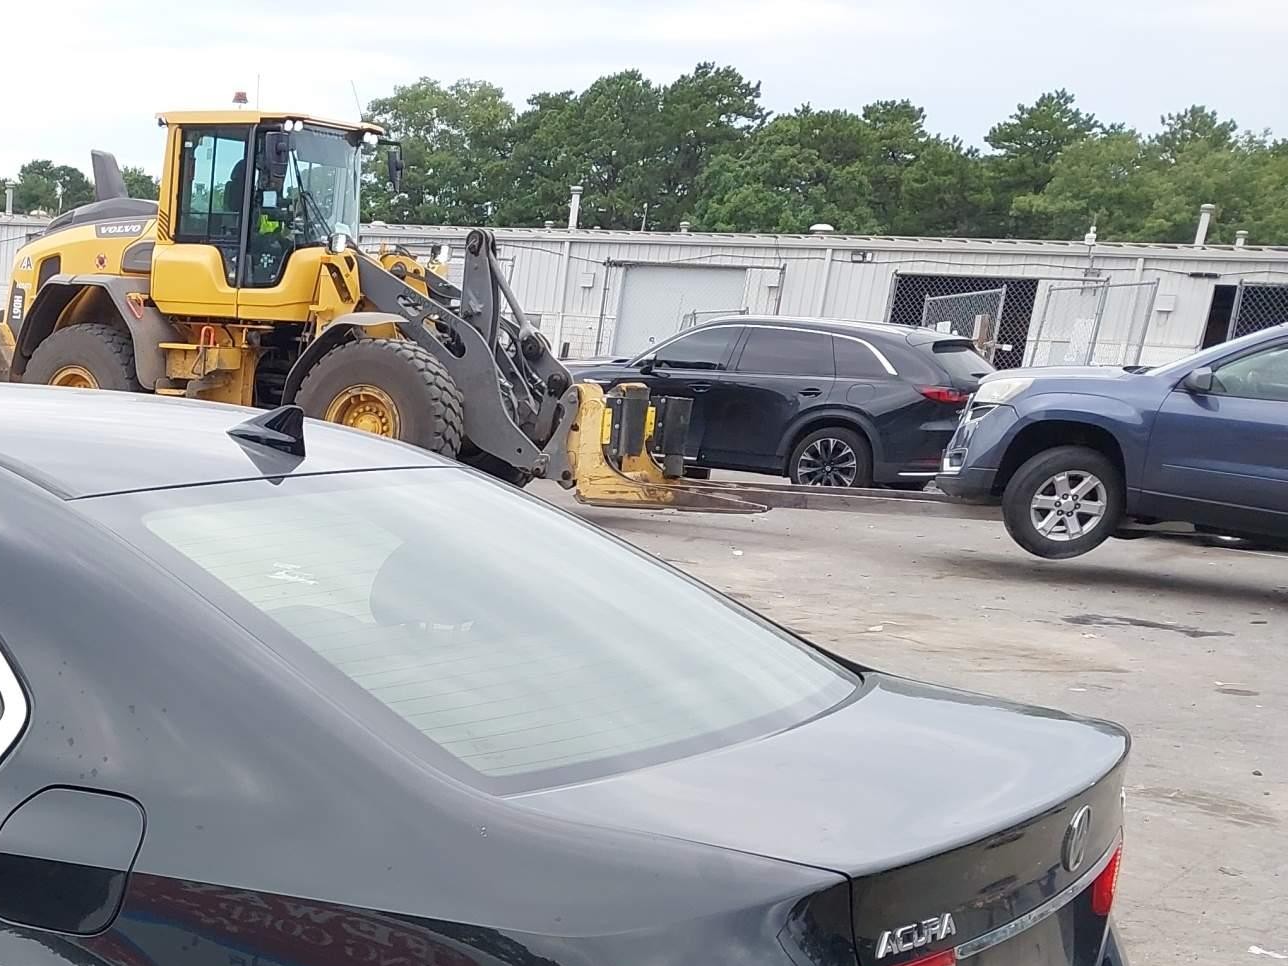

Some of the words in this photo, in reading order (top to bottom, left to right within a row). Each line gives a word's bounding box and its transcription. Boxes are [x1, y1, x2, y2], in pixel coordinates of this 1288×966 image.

[100, 224, 141, 234] VOLVO
[12, 295, 23, 320] L90H
[875, 913, 956, 959] ACURA
